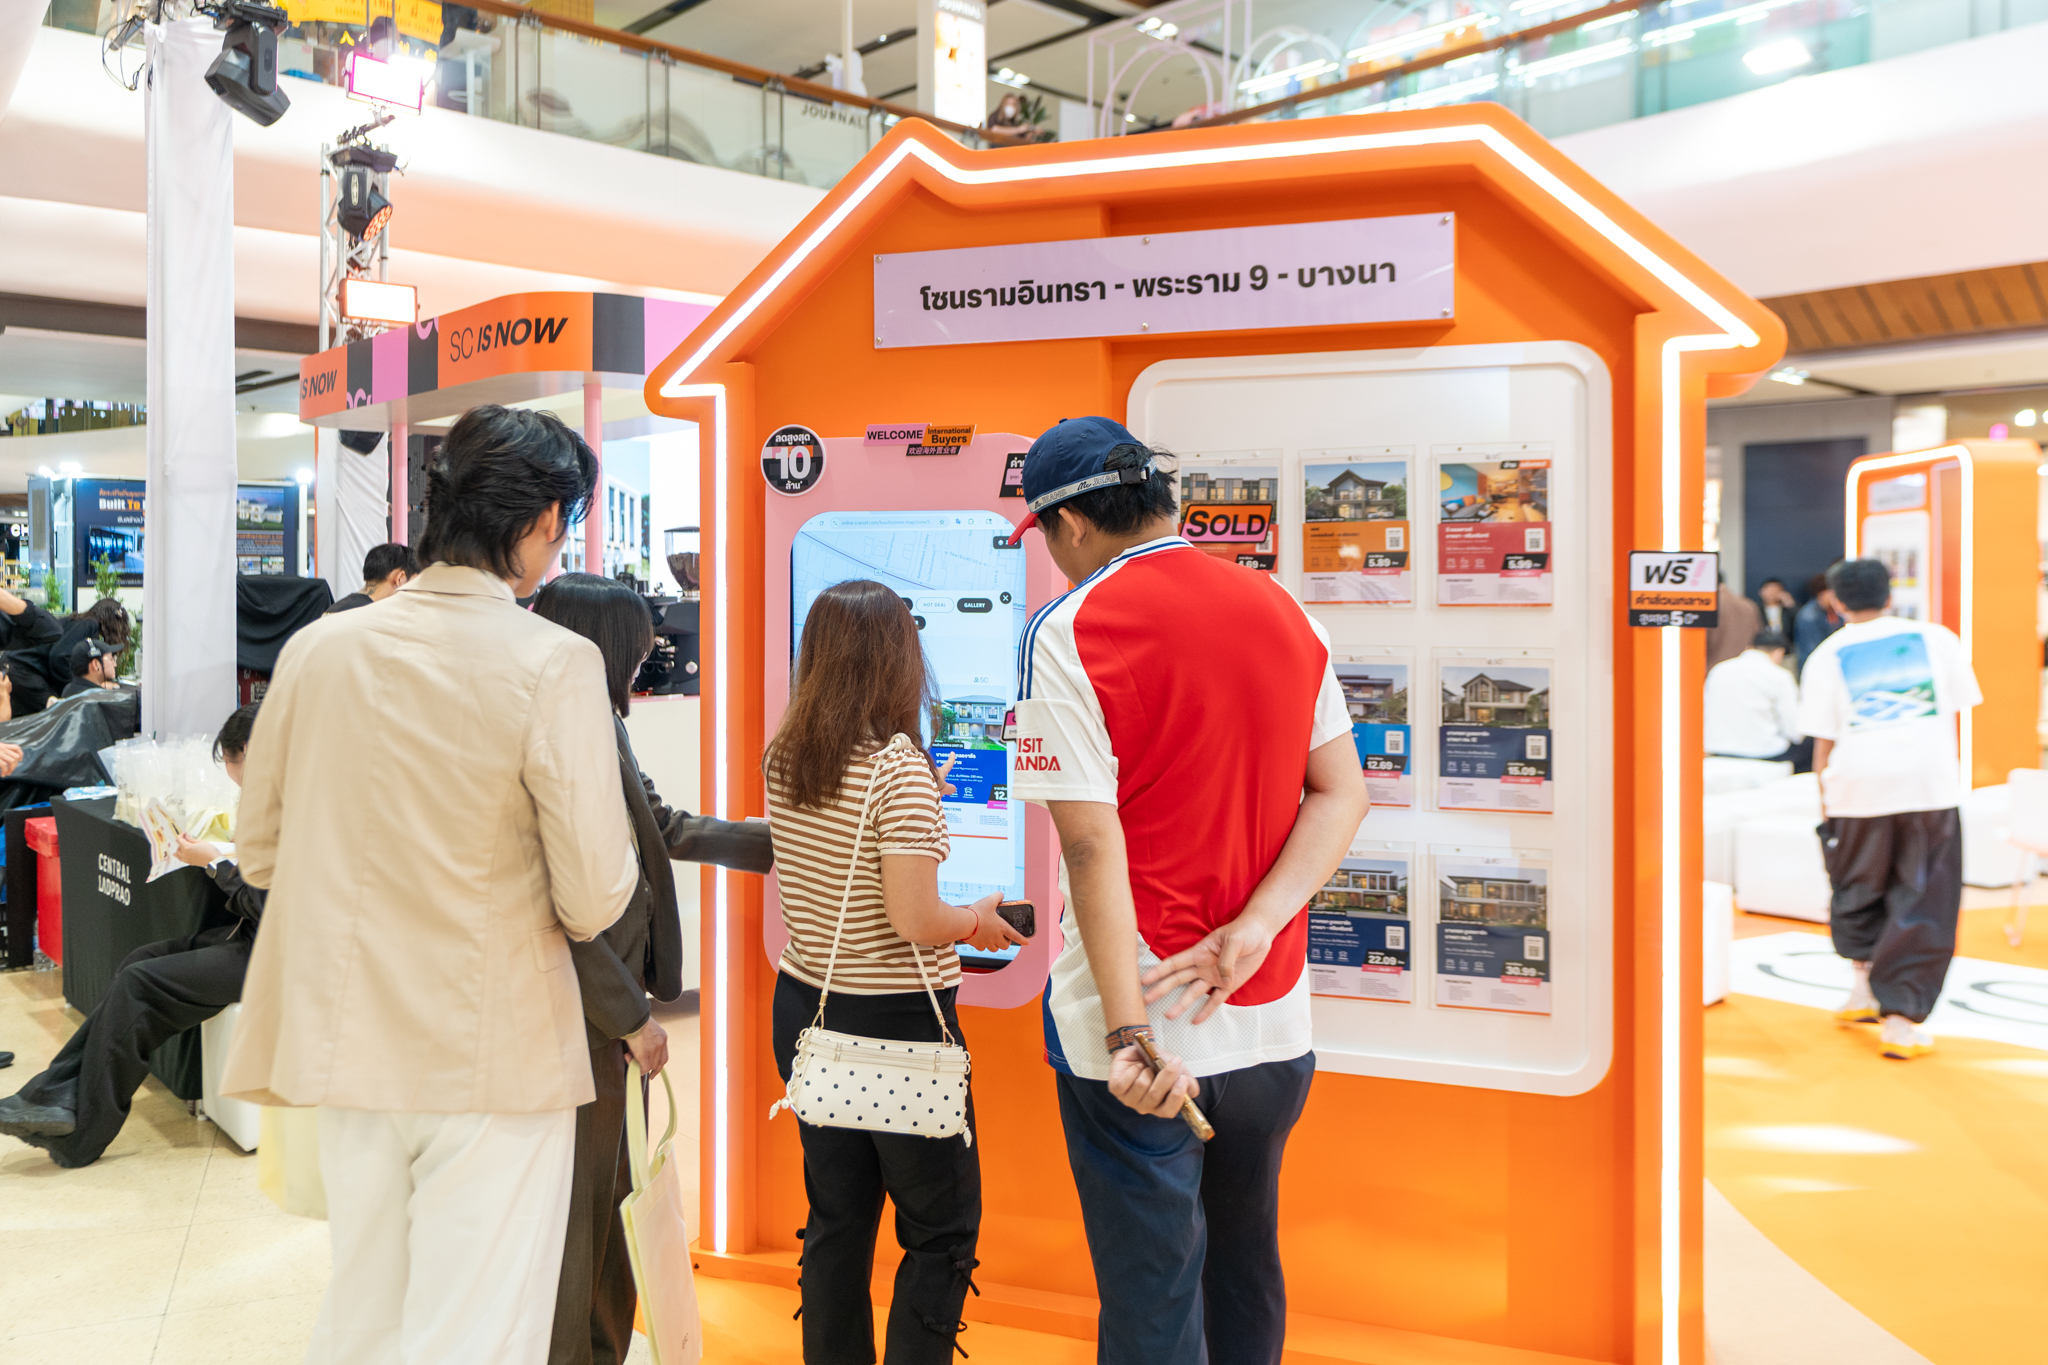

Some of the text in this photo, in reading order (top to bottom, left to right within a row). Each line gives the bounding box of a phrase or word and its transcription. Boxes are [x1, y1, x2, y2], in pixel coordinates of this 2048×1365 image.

[801, 103, 865, 129] JOURNAL
[920, 279, 1106, 311] โซนรามอินทรา
[1132, 269, 1241, 298] พระราม
[1250, 264, 1269, 291] 9
[1297, 259, 1396, 288] บางนา
[450, 327, 474, 362] SC
[494, 317, 568, 348] NOW
[309, 369, 337, 398] NOW
[867, 430, 923, 441] WELCOME
[927, 427, 972, 435] International
[775, 433, 811, 445] ลดสูงสุด
[931, 434, 968, 446] Buyers
[908, 446, 957, 455] 欢迎海外置业者
[775, 445, 811, 480] 10
[1010, 455, 1026, 468] ค่า
[99, 498, 140, 510] Built To
[1186, 510, 1266, 537] SOLD
[1238, 560, 1258, 570] 469
[1644, 558, 1708, 586] ฟรี!
[1670, 611, 1684, 626] 5
[1017, 738, 1043, 753] ISIT
[1015, 756, 1061, 771] ANDA
[1367, 760, 1393, 770] 12.69
[1508, 766, 1536, 776] 15.09
[98, 852, 131, 884] CENTRAL
[98, 875, 131, 906] LADPRAO
[1368, 955, 1397, 965] 22.09
